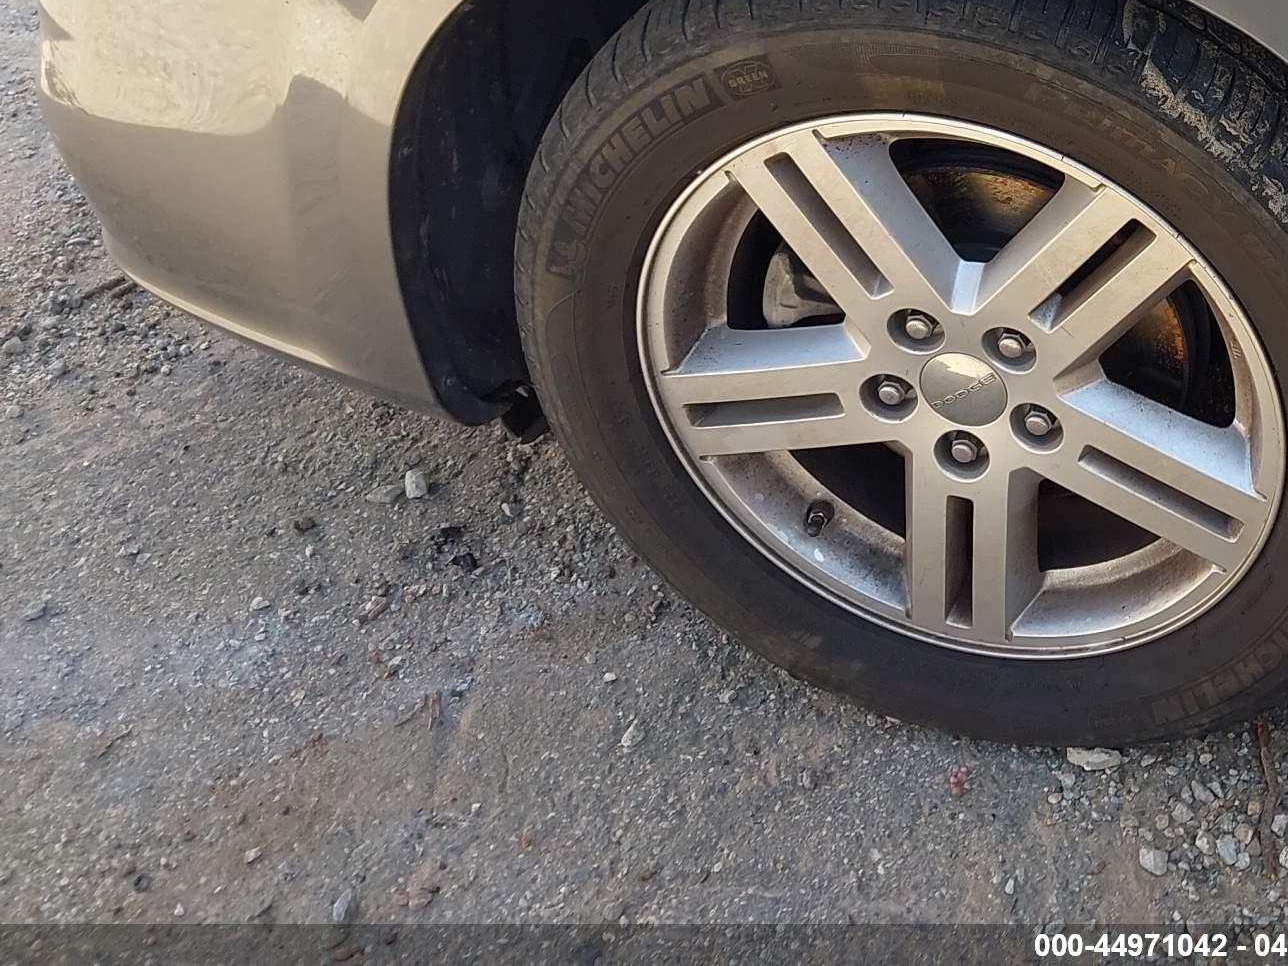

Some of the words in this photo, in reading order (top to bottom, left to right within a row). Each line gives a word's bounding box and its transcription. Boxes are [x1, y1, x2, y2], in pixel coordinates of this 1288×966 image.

[727, 70, 769, 89] GREEN
[564, 78, 713, 237] MICHELIN
[931, 372, 998, 409] DODGE
